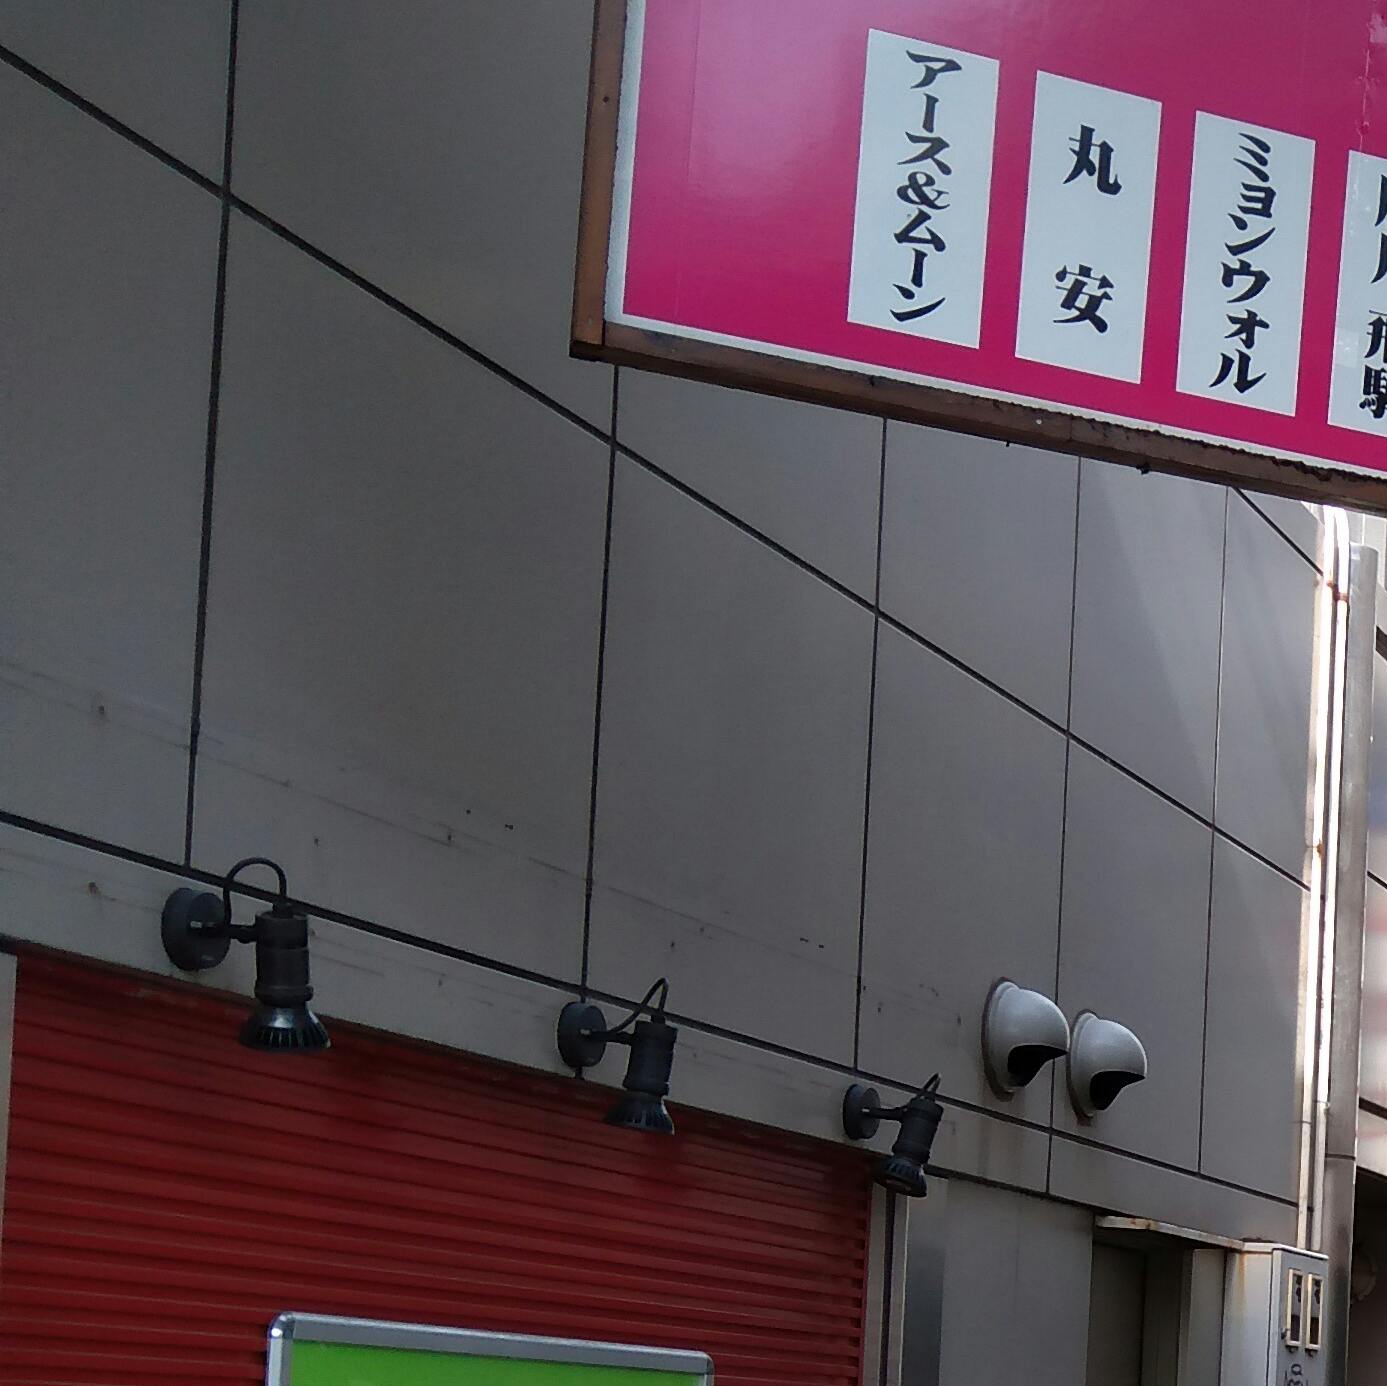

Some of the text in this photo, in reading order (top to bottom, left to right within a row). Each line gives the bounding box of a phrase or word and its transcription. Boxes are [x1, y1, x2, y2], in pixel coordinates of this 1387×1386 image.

[890, 50, 962, 322] アース&ムーン
